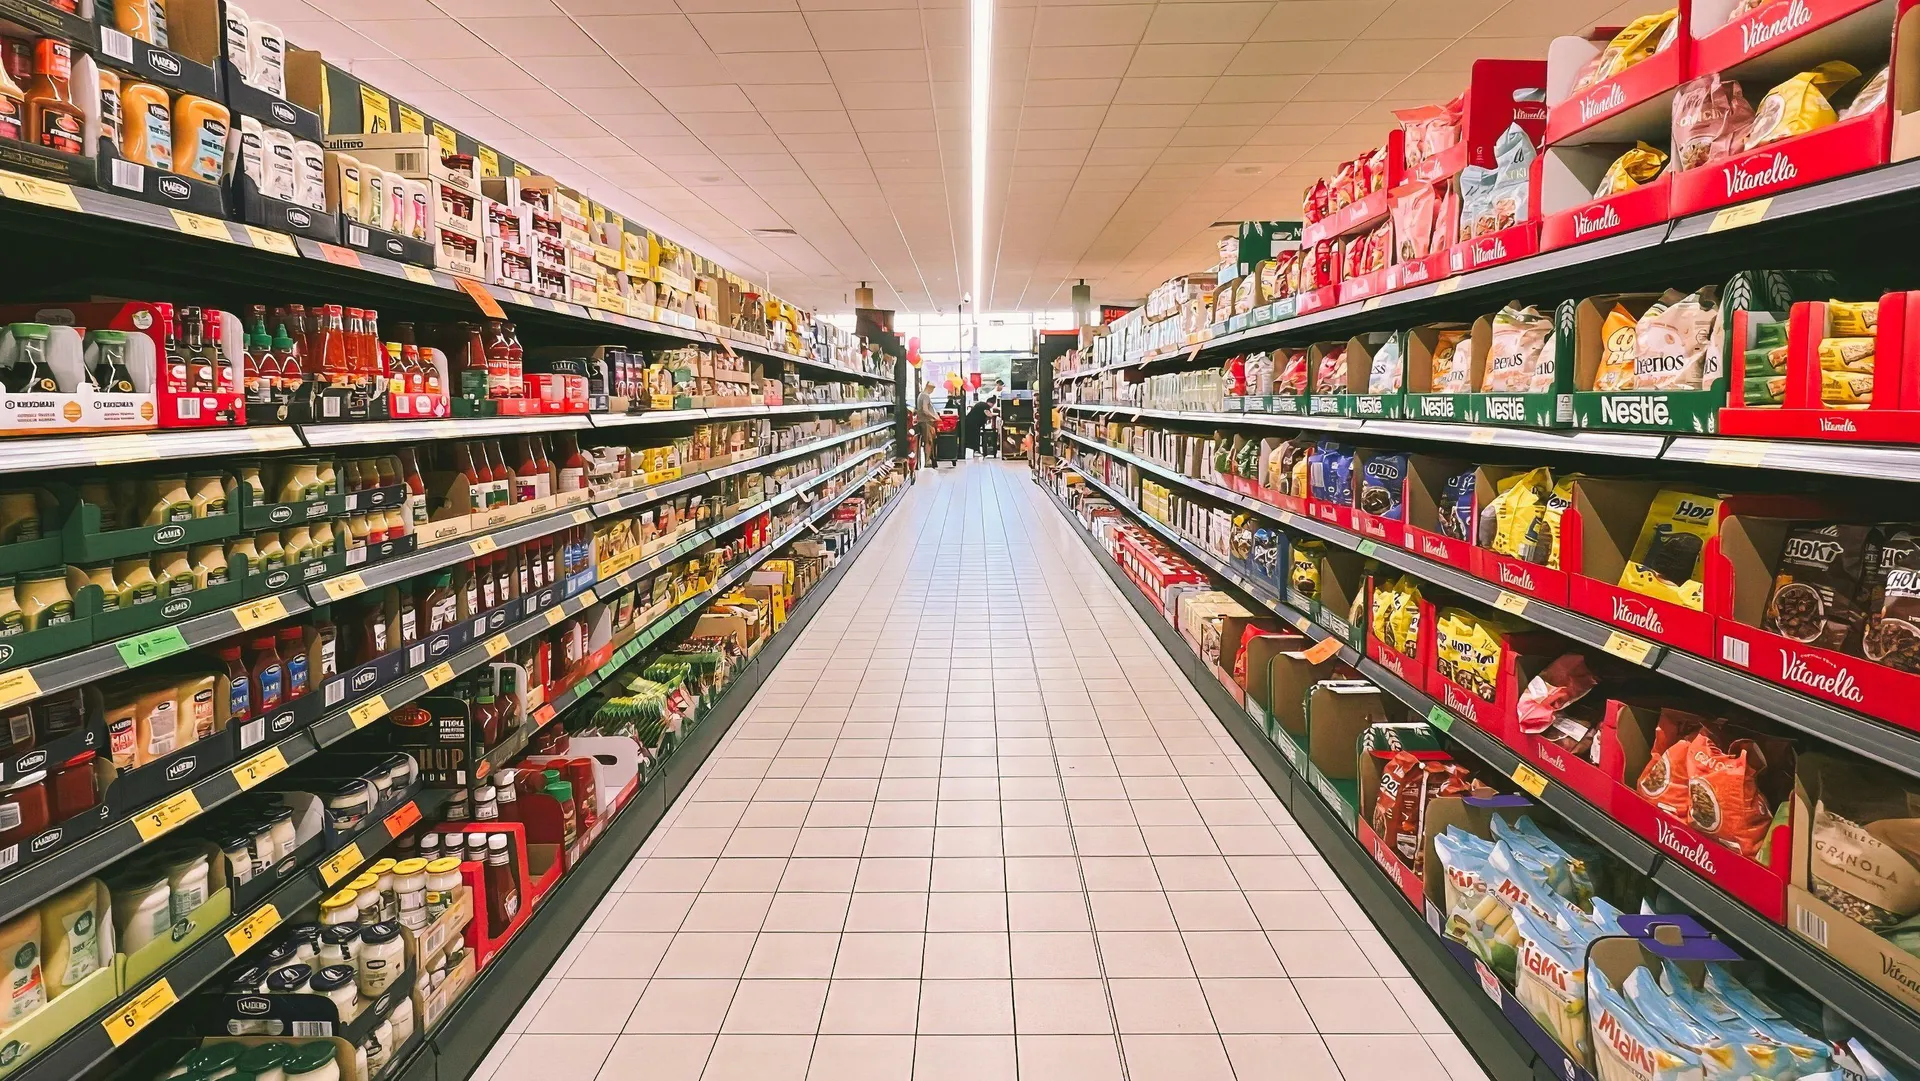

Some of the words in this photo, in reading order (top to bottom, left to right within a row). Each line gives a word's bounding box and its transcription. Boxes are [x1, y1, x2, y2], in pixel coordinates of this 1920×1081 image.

[1741, 0, 1812, 53] Vitanella
[1579, 83, 1626, 124] Vitanella
[1723, 152, 1798, 197] Vitanella
[1573, 204, 1620, 238] Vitanella
[1472, 237, 1507, 260] Vitanella
[157, 528, 181, 540] KAMIS
[1498, 562, 1535, 591] Vitanella
[164, 601, 188, 614] KAMIS
[1612, 595, 1664, 634] Vitanella
[1780, 649, 1864, 702] Vitanella
[1444, 683, 1478, 722] Vitanella
[1656, 818, 1717, 875] Vitanella
[1815, 839, 1898, 884] GRANOLA
[1522, 940, 1567, 992] iaMi
